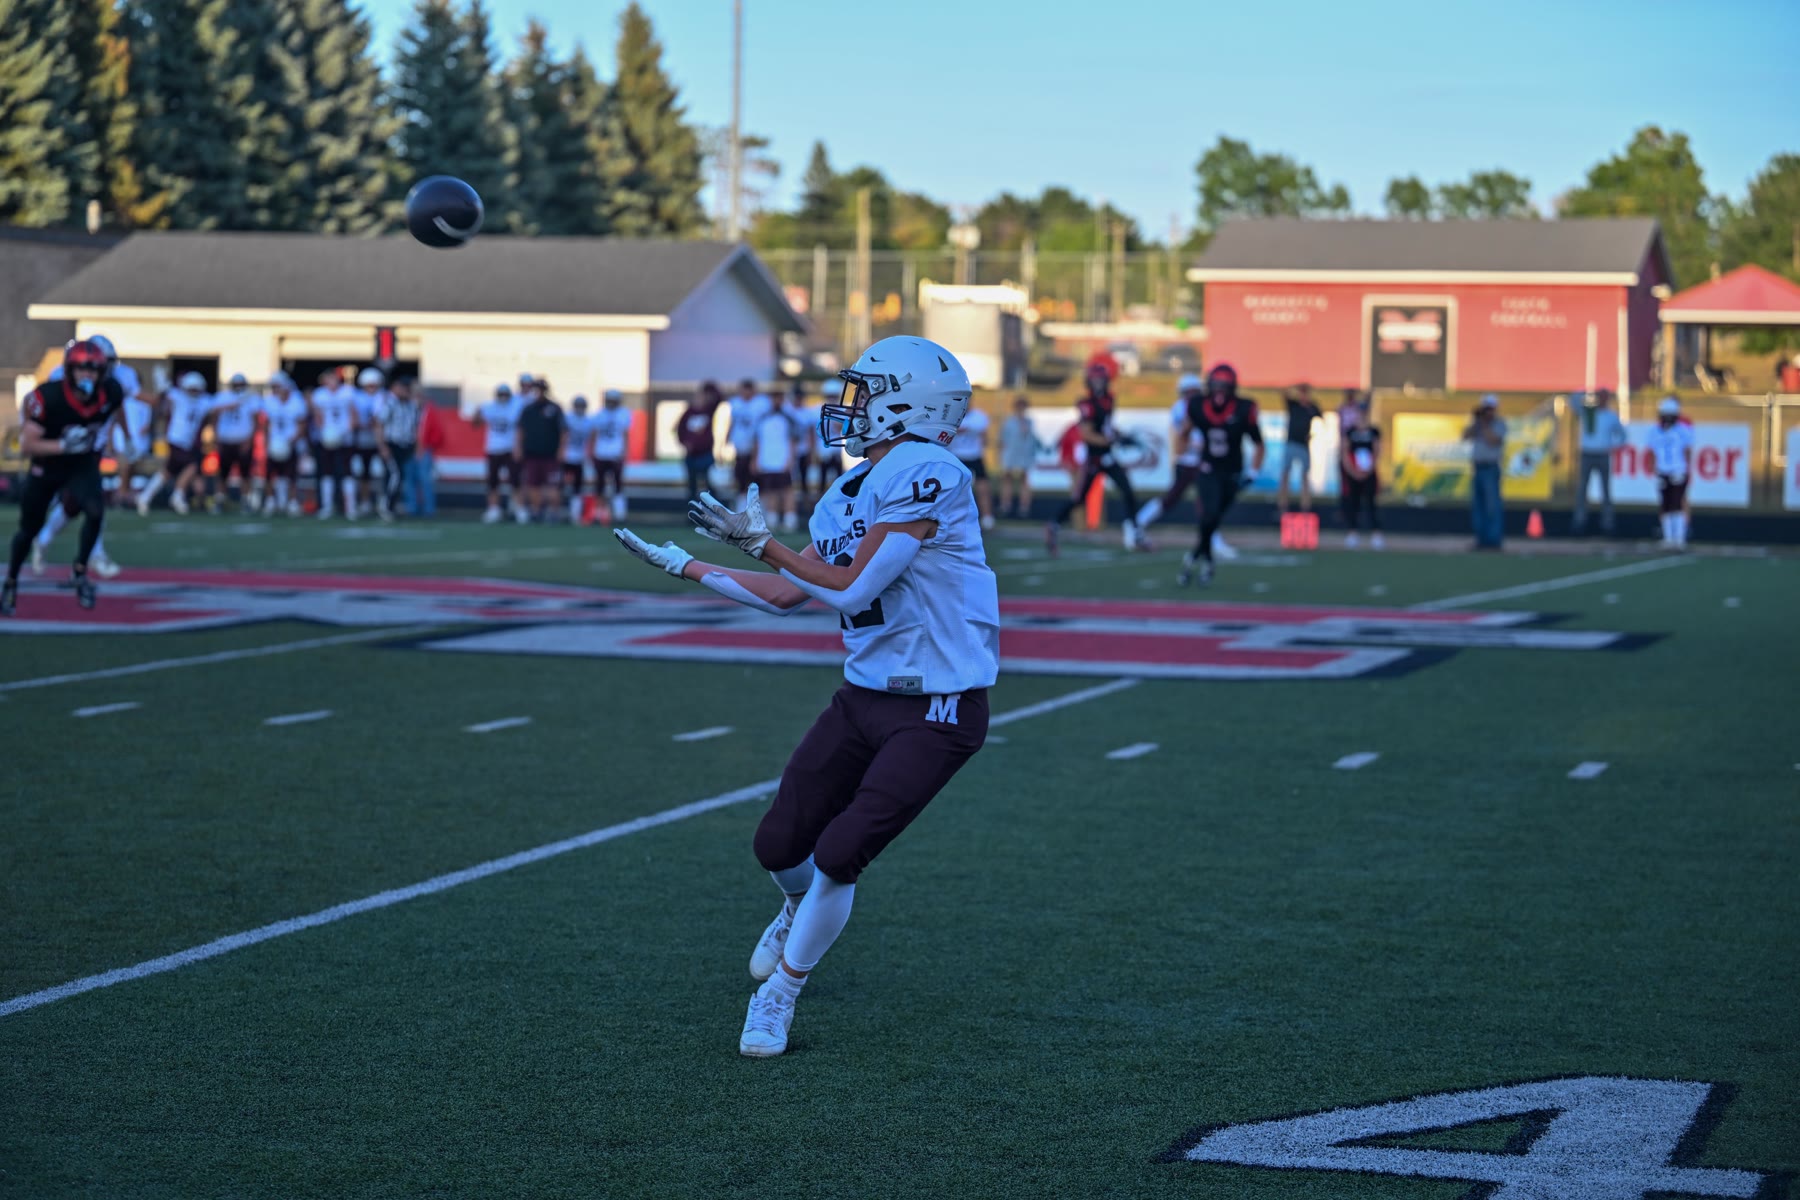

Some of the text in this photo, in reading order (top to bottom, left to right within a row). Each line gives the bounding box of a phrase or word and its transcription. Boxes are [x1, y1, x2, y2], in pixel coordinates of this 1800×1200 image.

[912, 477, 942, 503] 12
[925, 694, 961, 725] M
[1184, 1075, 1766, 1200] 4
